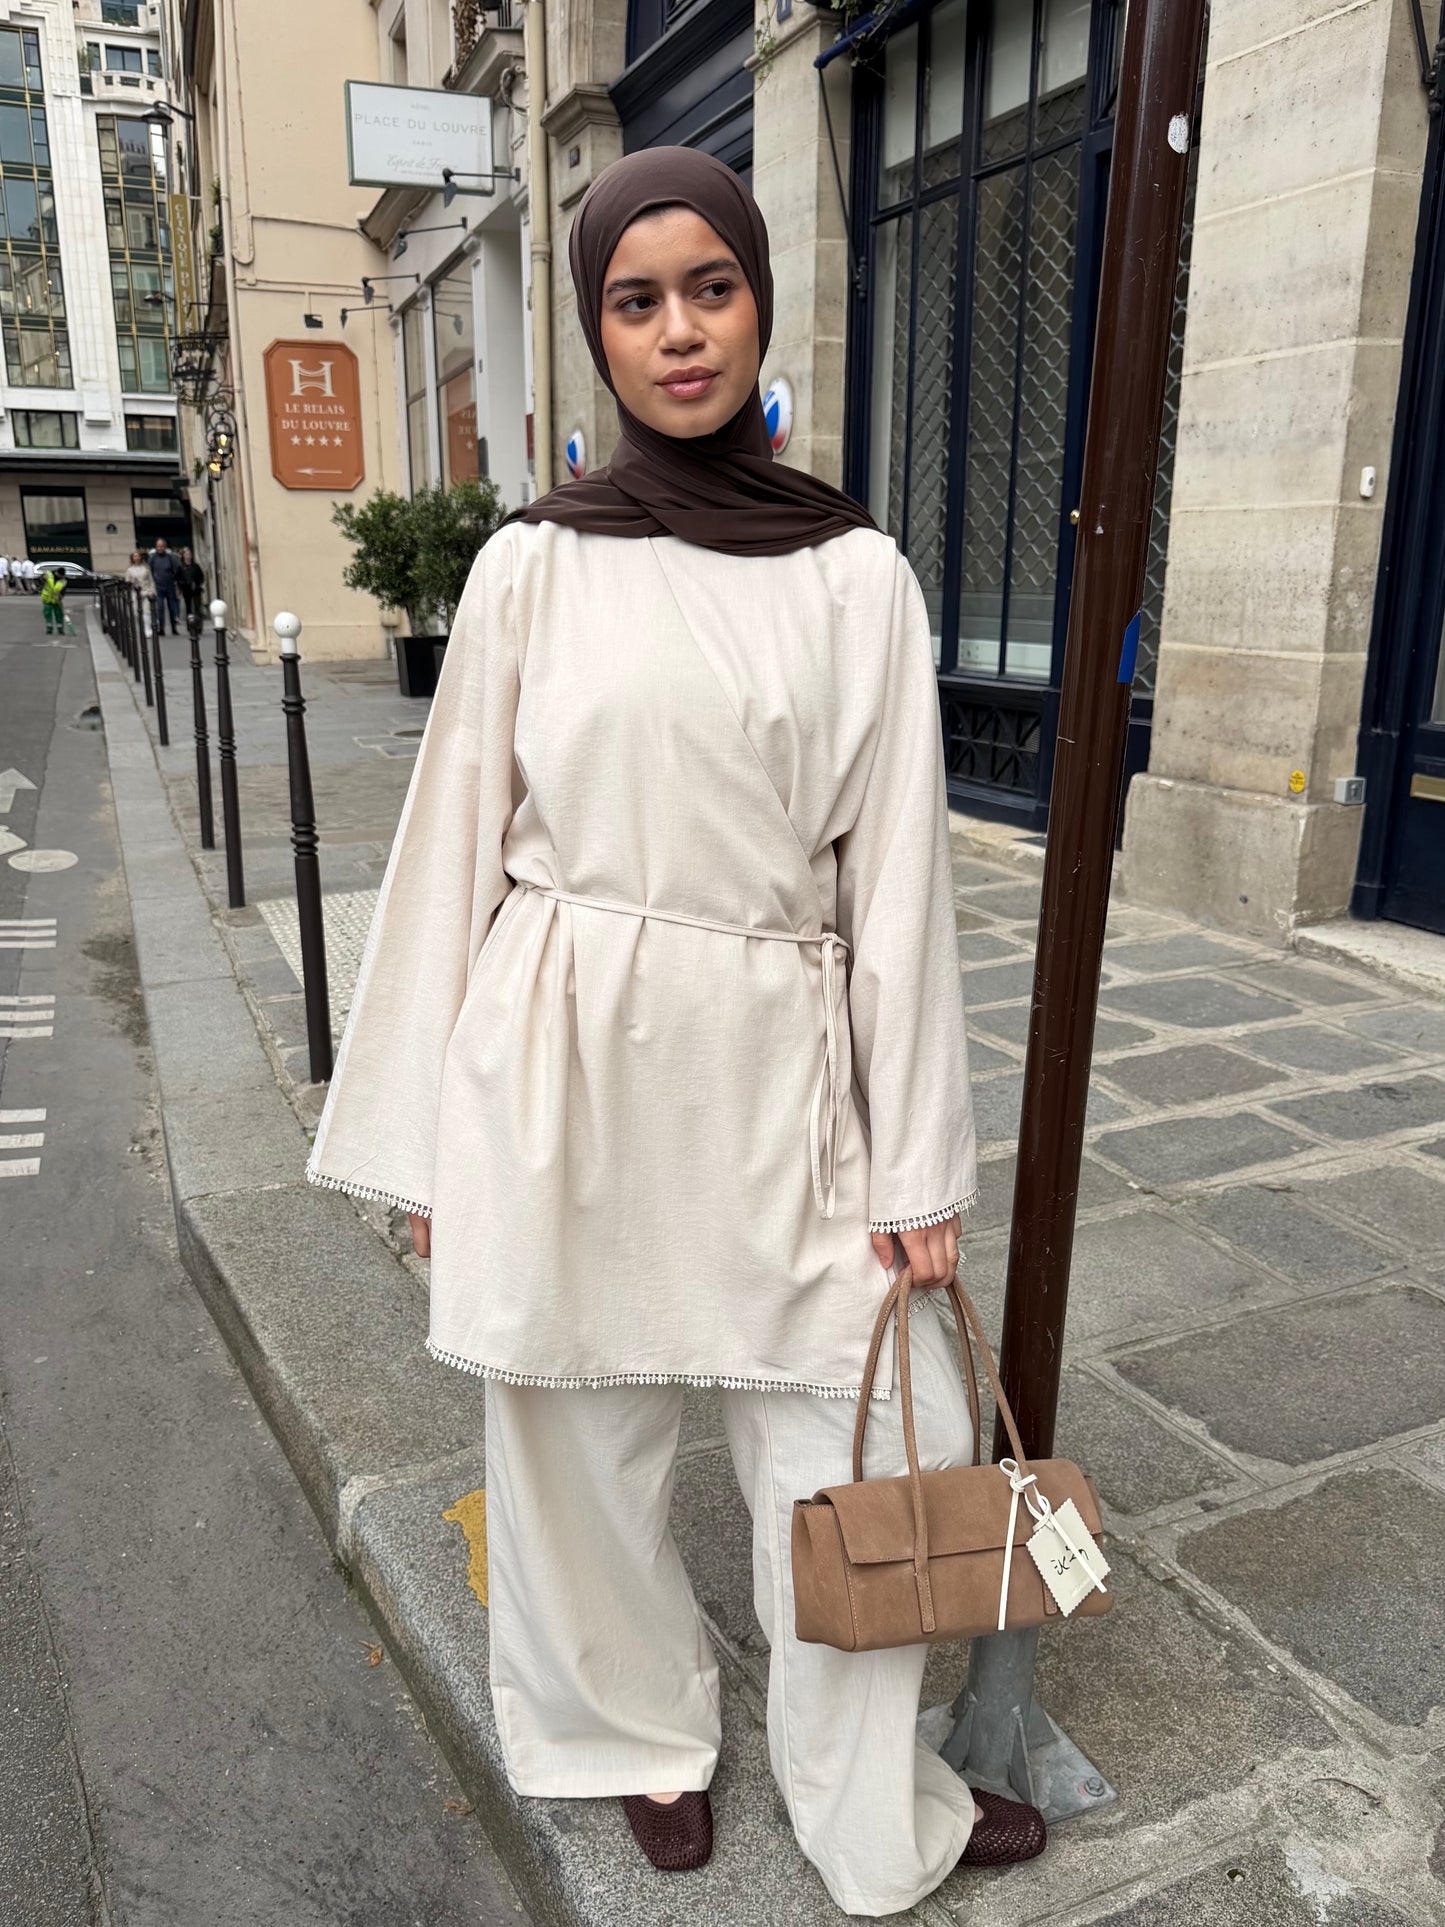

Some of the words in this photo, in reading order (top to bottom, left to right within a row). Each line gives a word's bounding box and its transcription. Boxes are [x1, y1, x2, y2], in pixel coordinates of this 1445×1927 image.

[355, 113, 400, 128] PLACE
[408, 118, 426, 130] DU
[433, 122, 487, 136] LOUVRE
[180, 271, 190, 287] DU
[284, 403, 300, 413] LE
[303, 403, 345, 415] RELAIS
[281, 419, 299, 430] DU
[302, 420, 350, 431] LOUVRE
